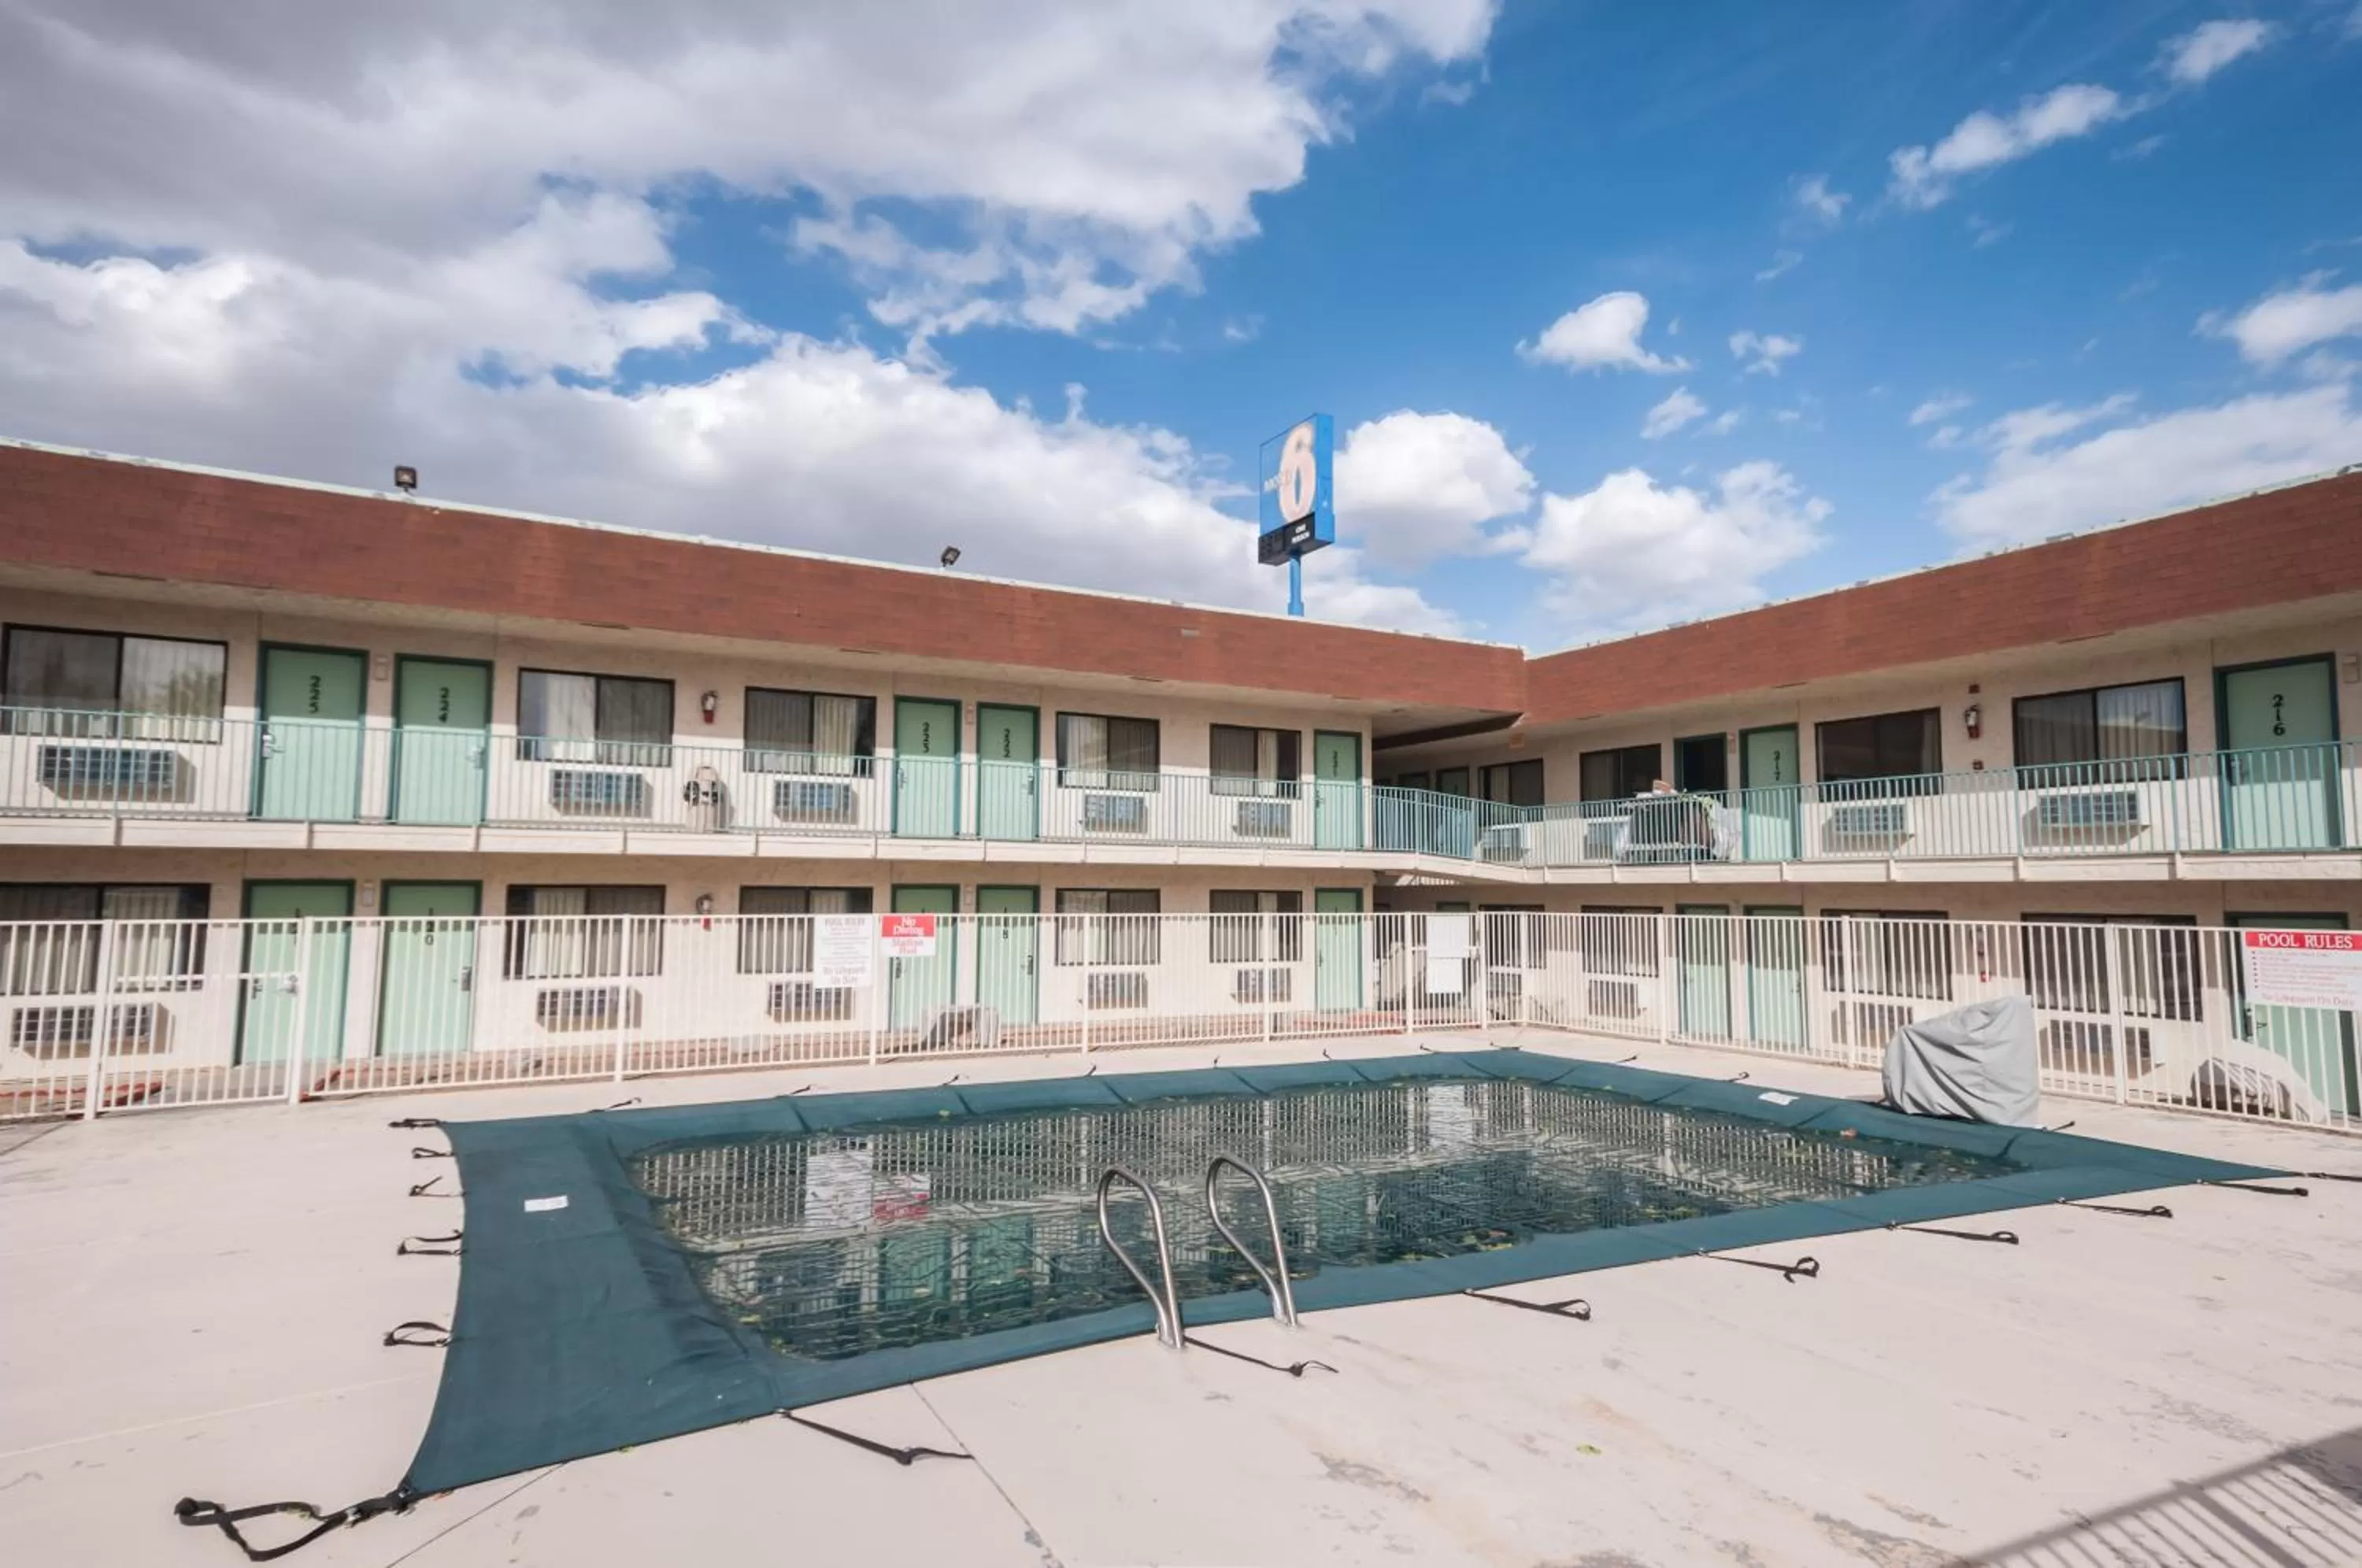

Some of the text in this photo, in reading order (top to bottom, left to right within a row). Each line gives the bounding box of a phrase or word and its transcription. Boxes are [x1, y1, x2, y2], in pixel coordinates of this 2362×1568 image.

[1279, 422, 1316, 523] 6
[308, 675, 321, 714] 225
[438, 686, 450, 723] 224
[2272, 693, 2286, 737] 216
[901, 916, 916, 926] No
[2257, 933, 2353, 949] POOL RULES
